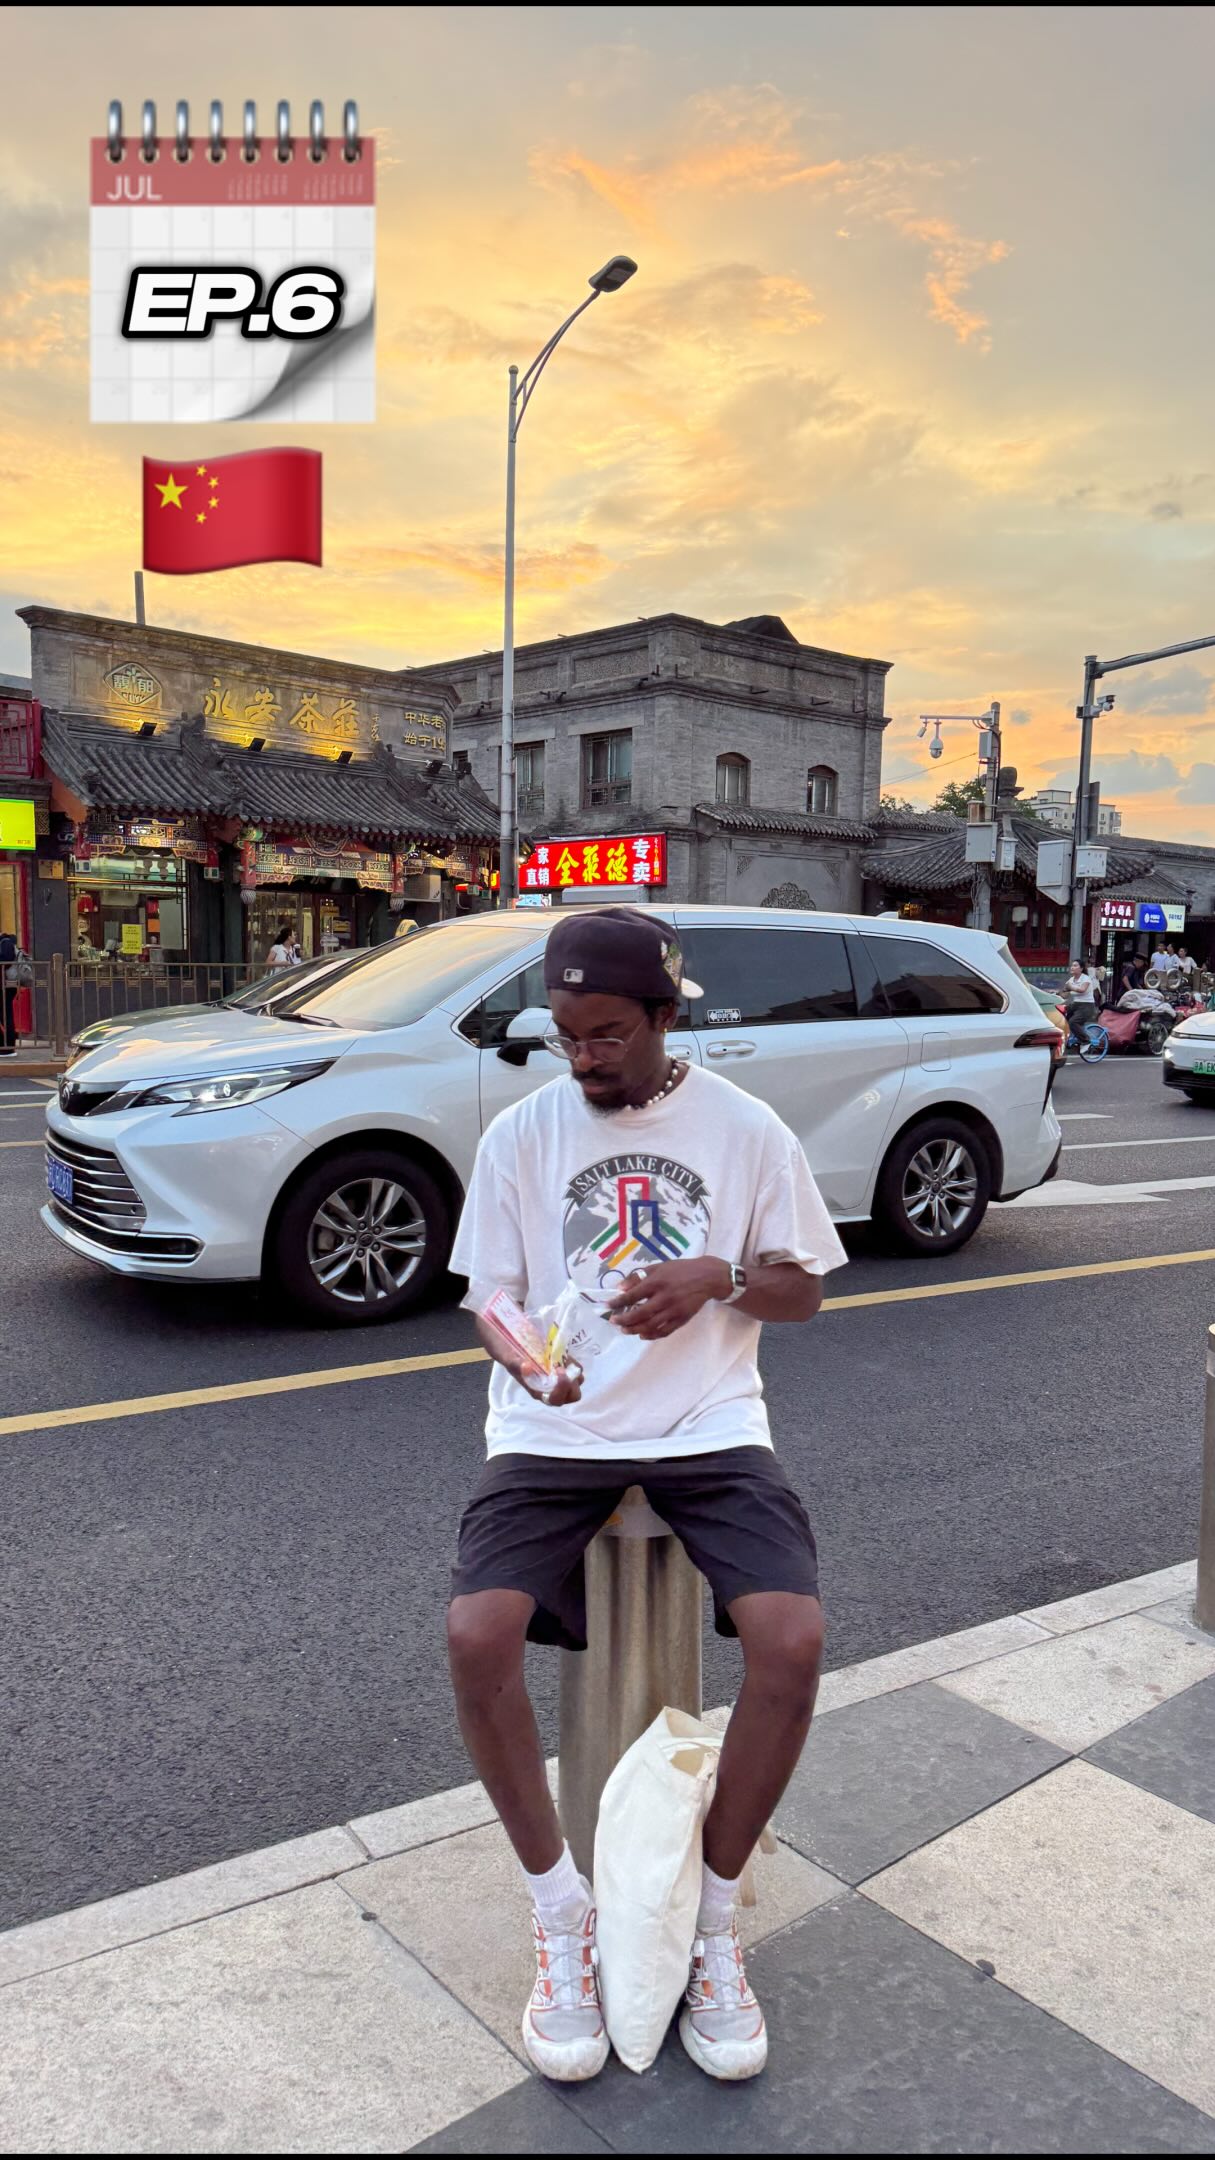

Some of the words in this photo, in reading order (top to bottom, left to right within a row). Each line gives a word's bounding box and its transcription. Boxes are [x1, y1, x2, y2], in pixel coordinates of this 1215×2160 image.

[526, 867, 550, 886] 直销
[632, 838, 651, 883] 专卖
[575, 1162, 611, 1192] SALT
[614, 1155, 657, 1173] LAKE
[661, 1162, 698, 1189] CITY
